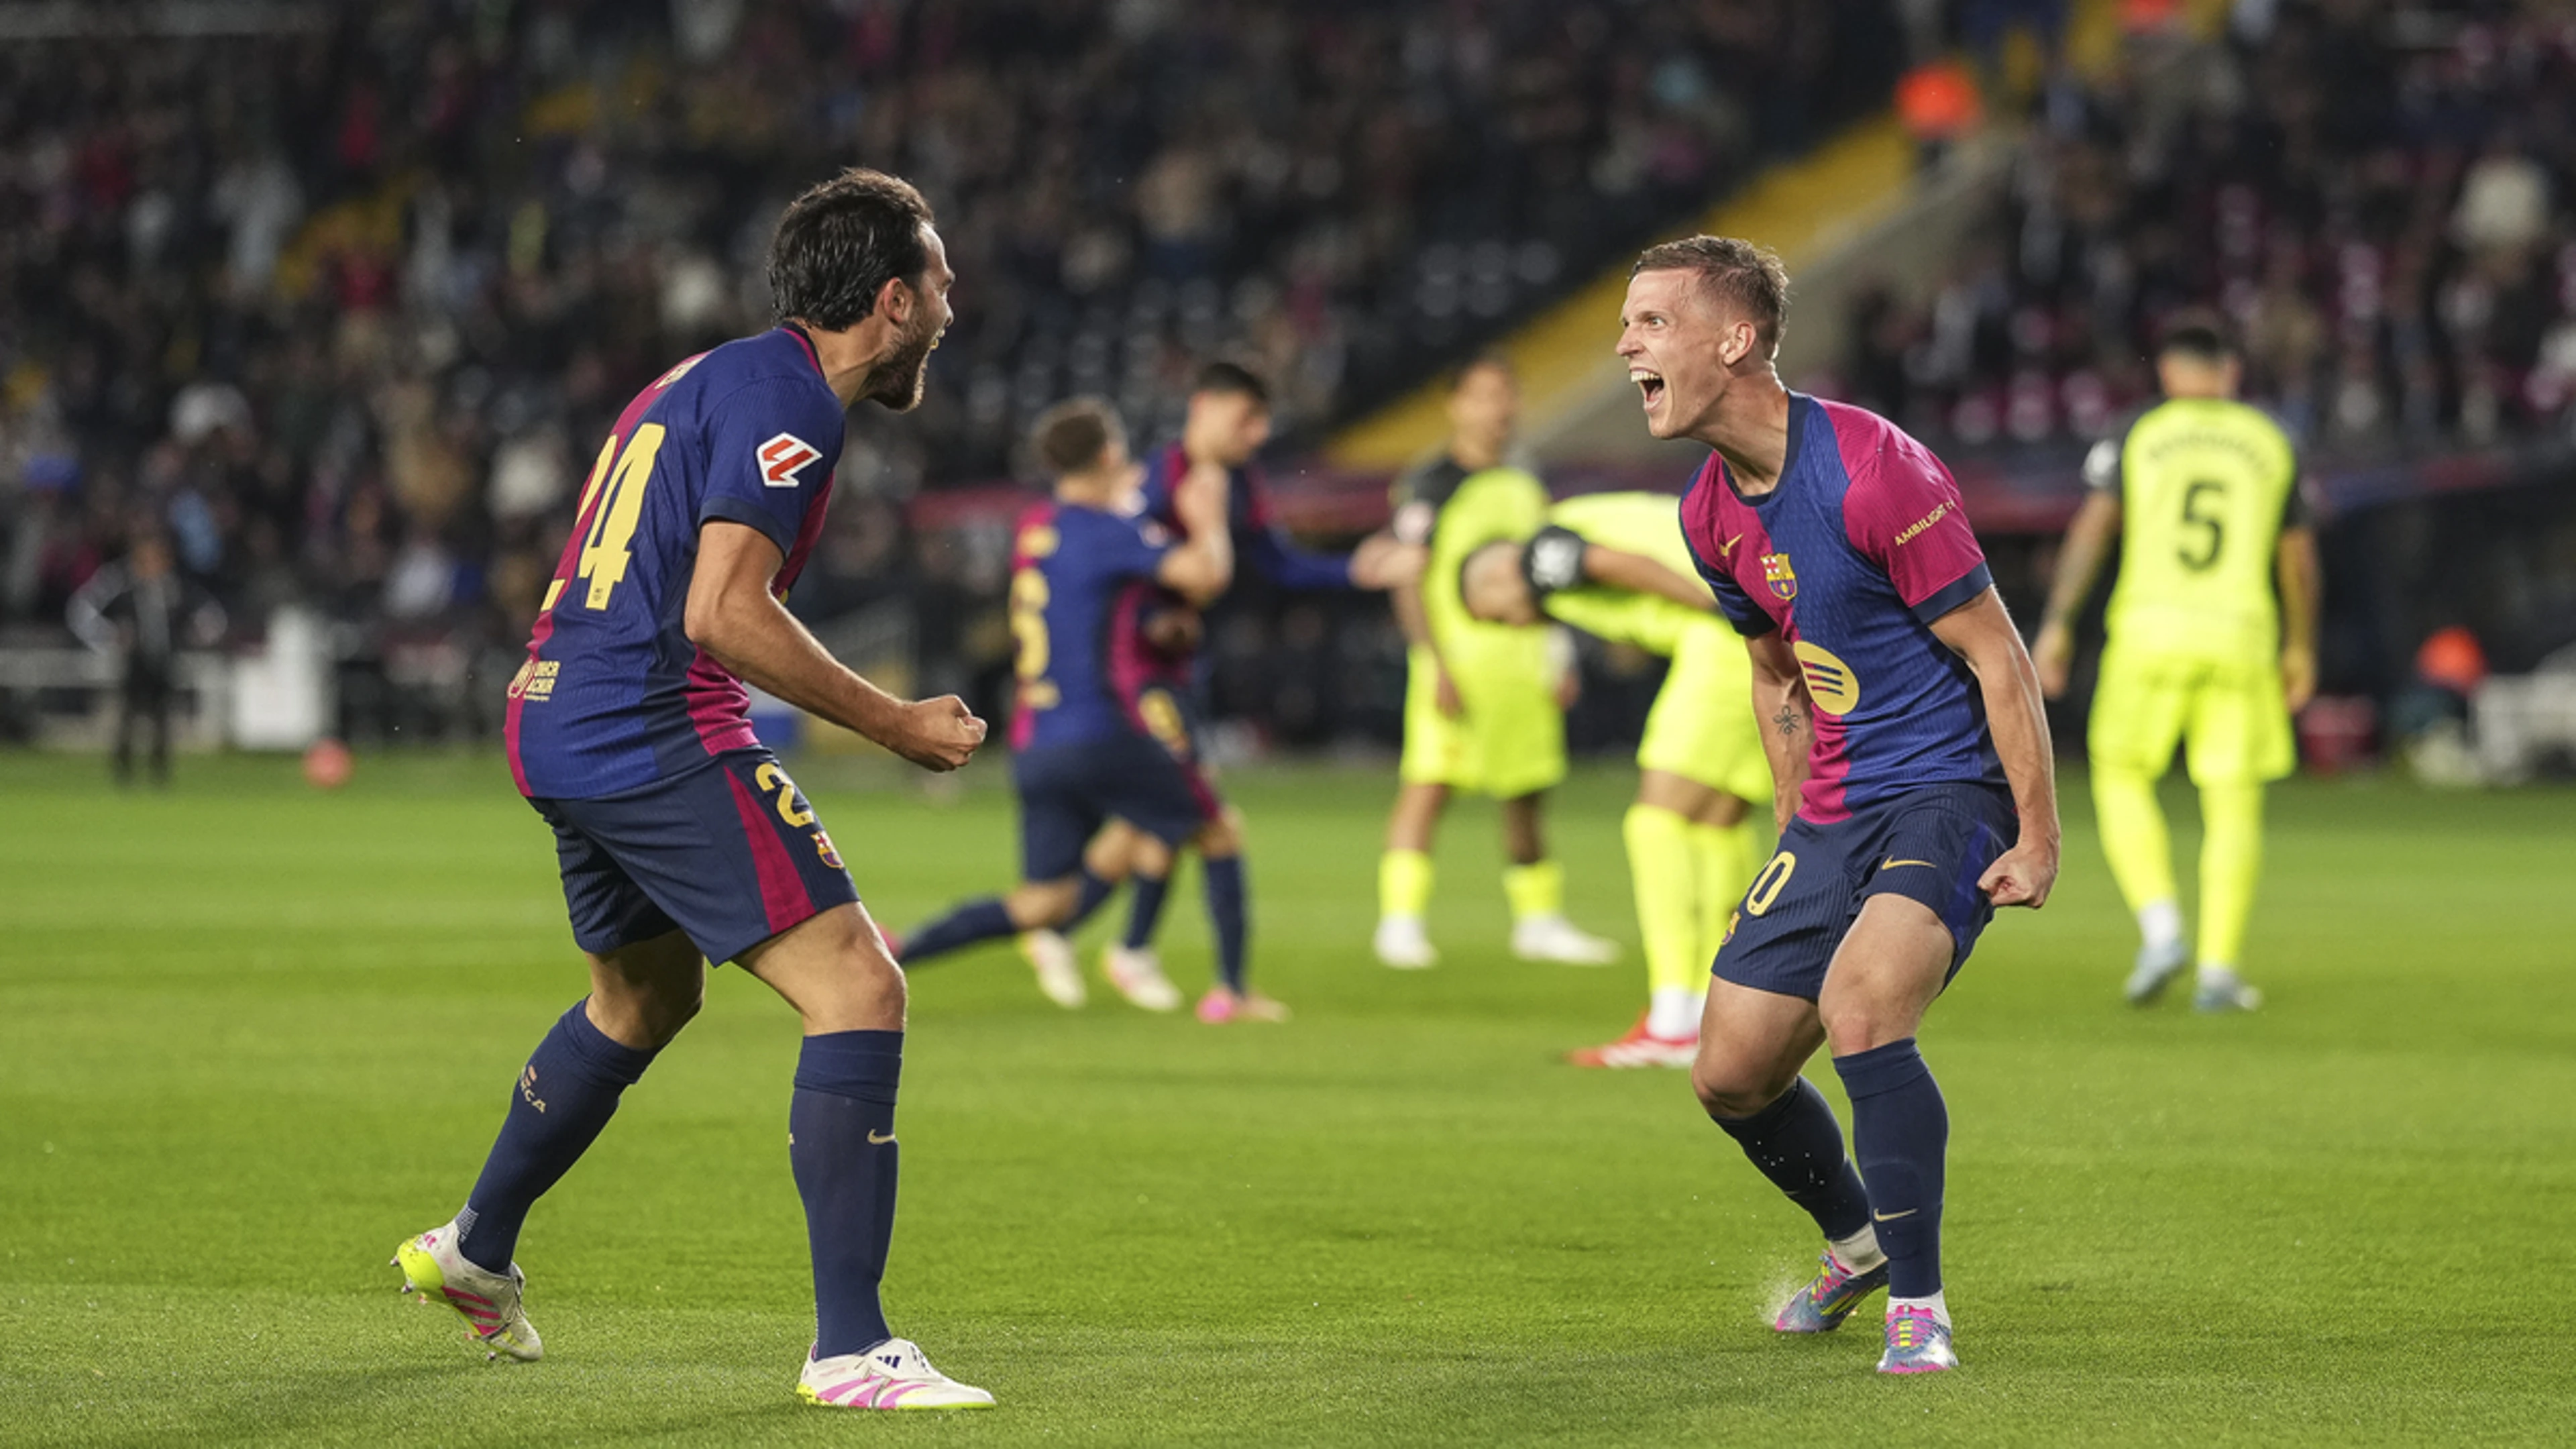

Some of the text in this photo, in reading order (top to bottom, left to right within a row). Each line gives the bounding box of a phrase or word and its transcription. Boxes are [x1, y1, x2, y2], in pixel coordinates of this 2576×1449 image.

[2178, 478, 2228, 572] 5
[755, 762, 815, 828] 2
[1746, 850, 1796, 916] 0
